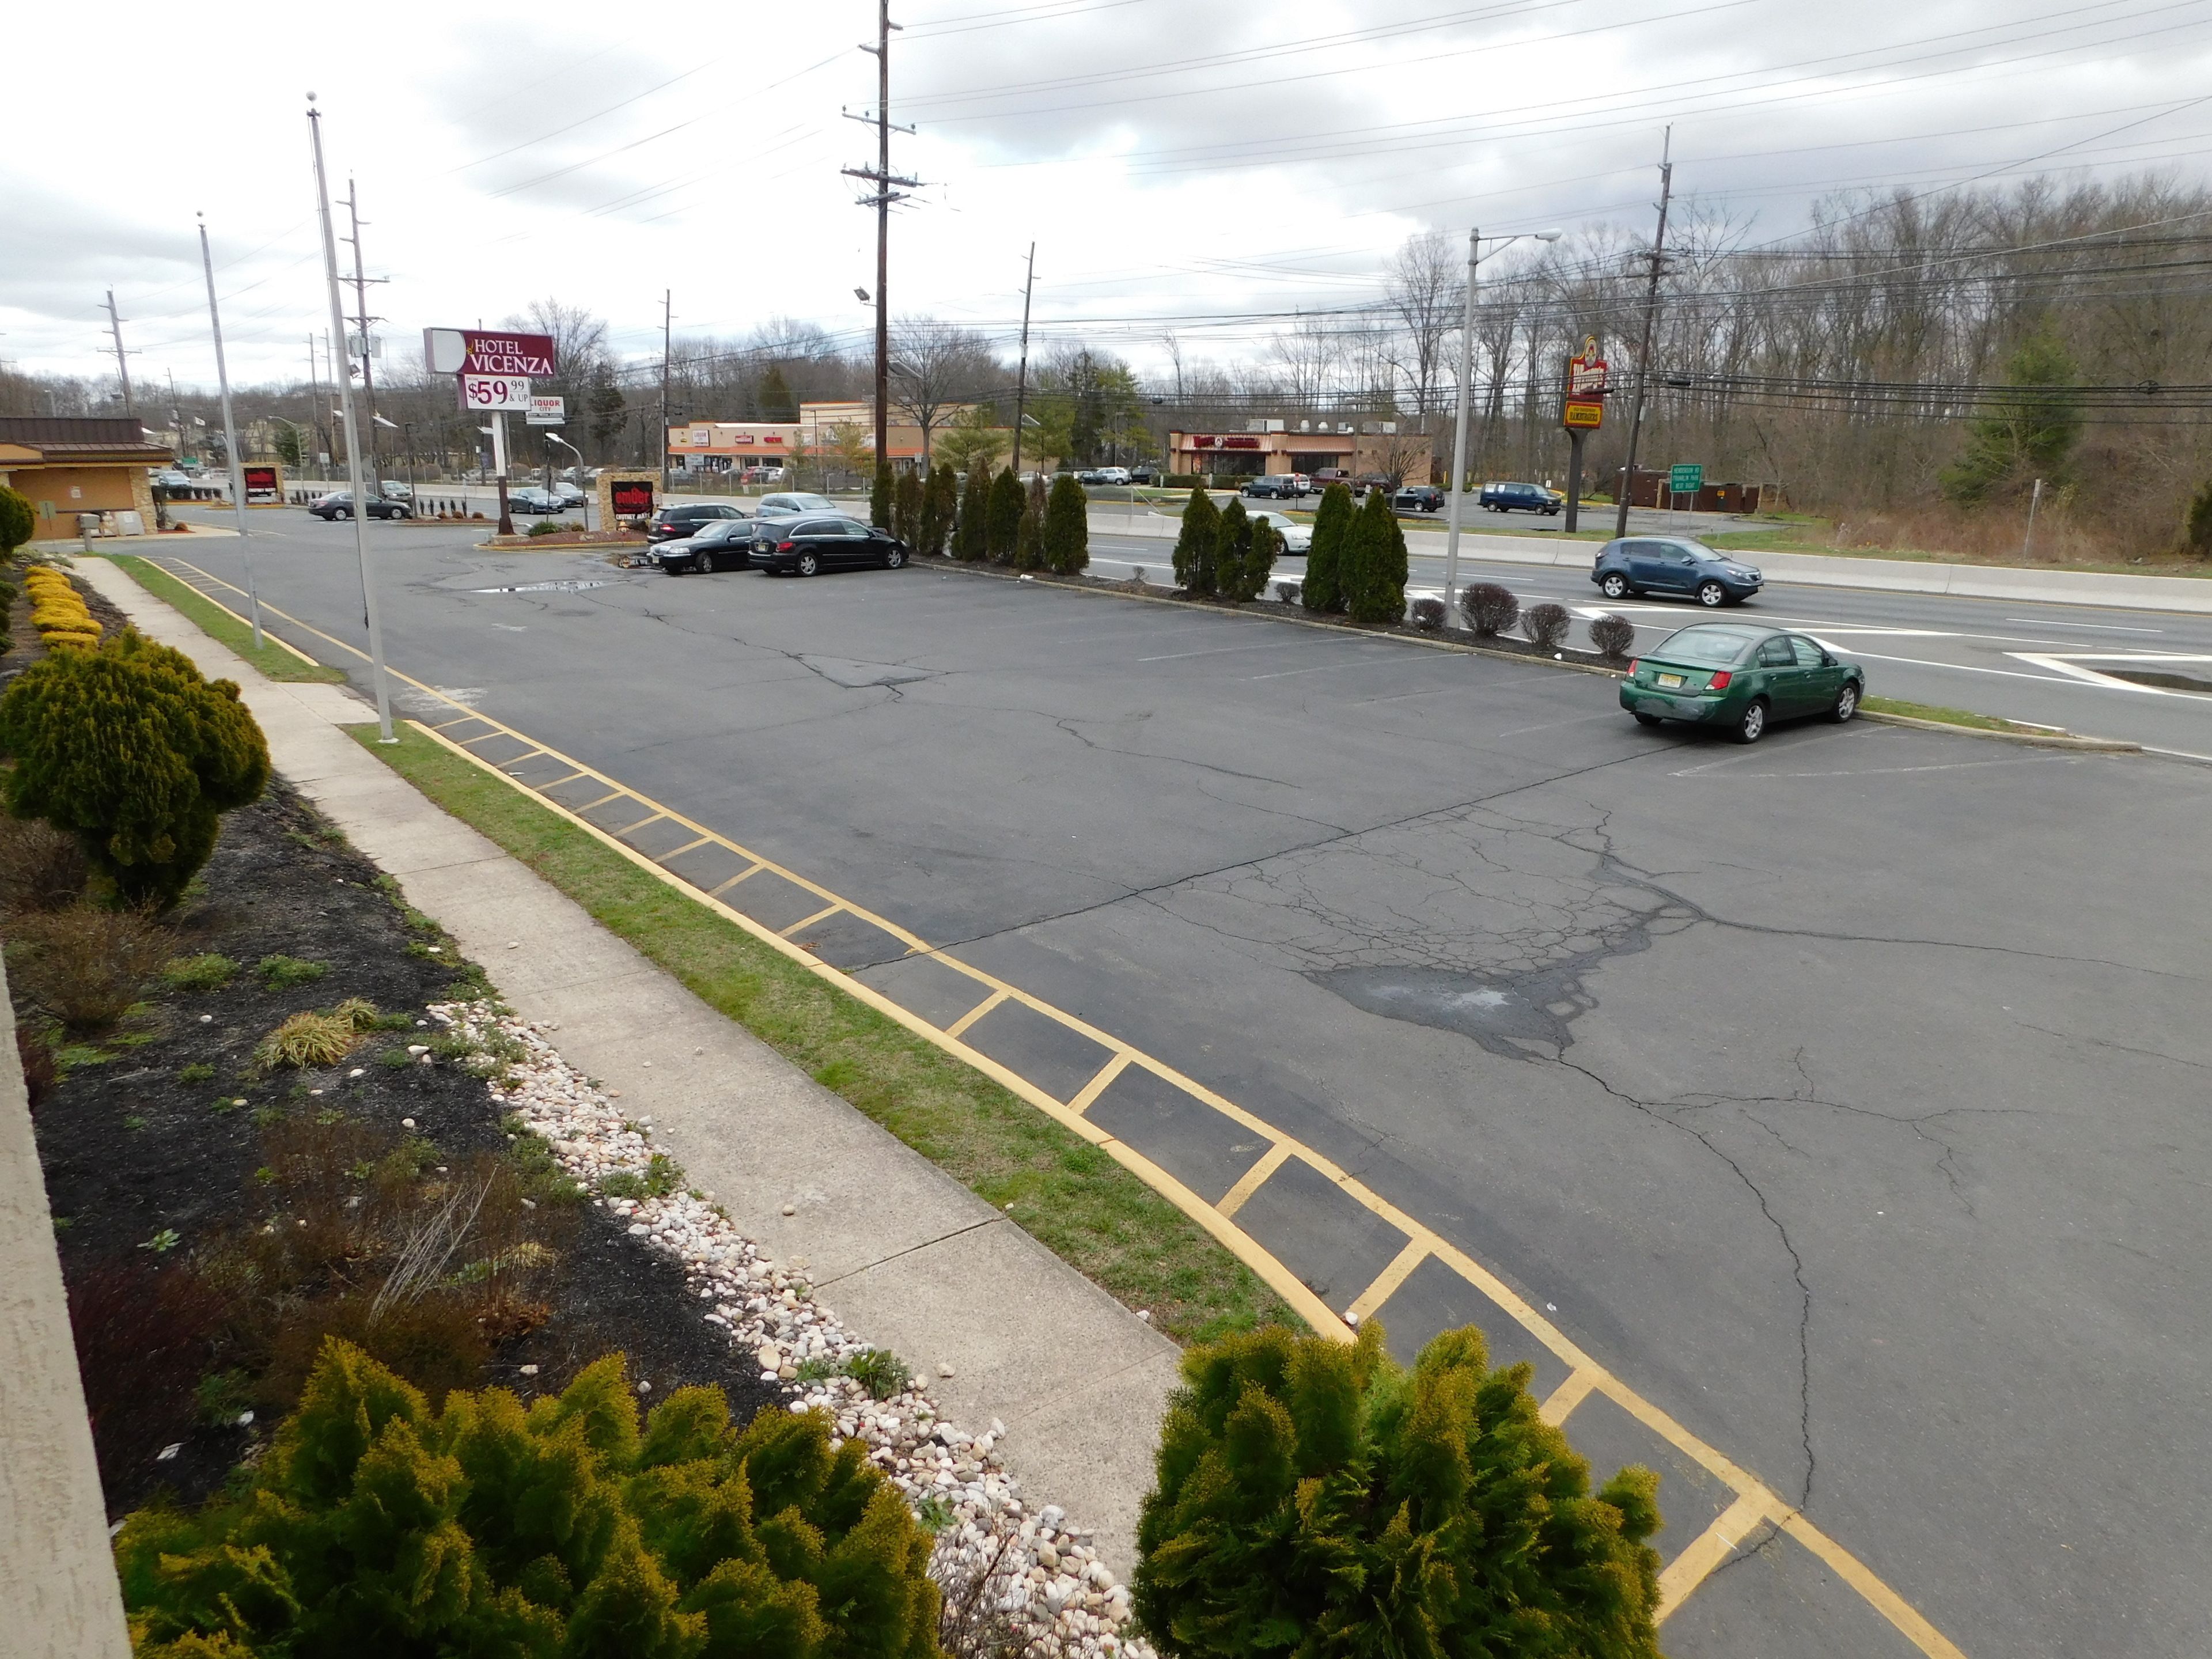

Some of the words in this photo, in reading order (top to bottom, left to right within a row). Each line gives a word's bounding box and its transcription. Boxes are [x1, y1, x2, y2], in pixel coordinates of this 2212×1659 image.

[474, 339, 523, 354] HOTEL
[469, 354, 554, 374] VICENZA
[511, 380, 524, 391] 99
[509, 393, 515, 402] &
[518, 394, 528, 402] UP
